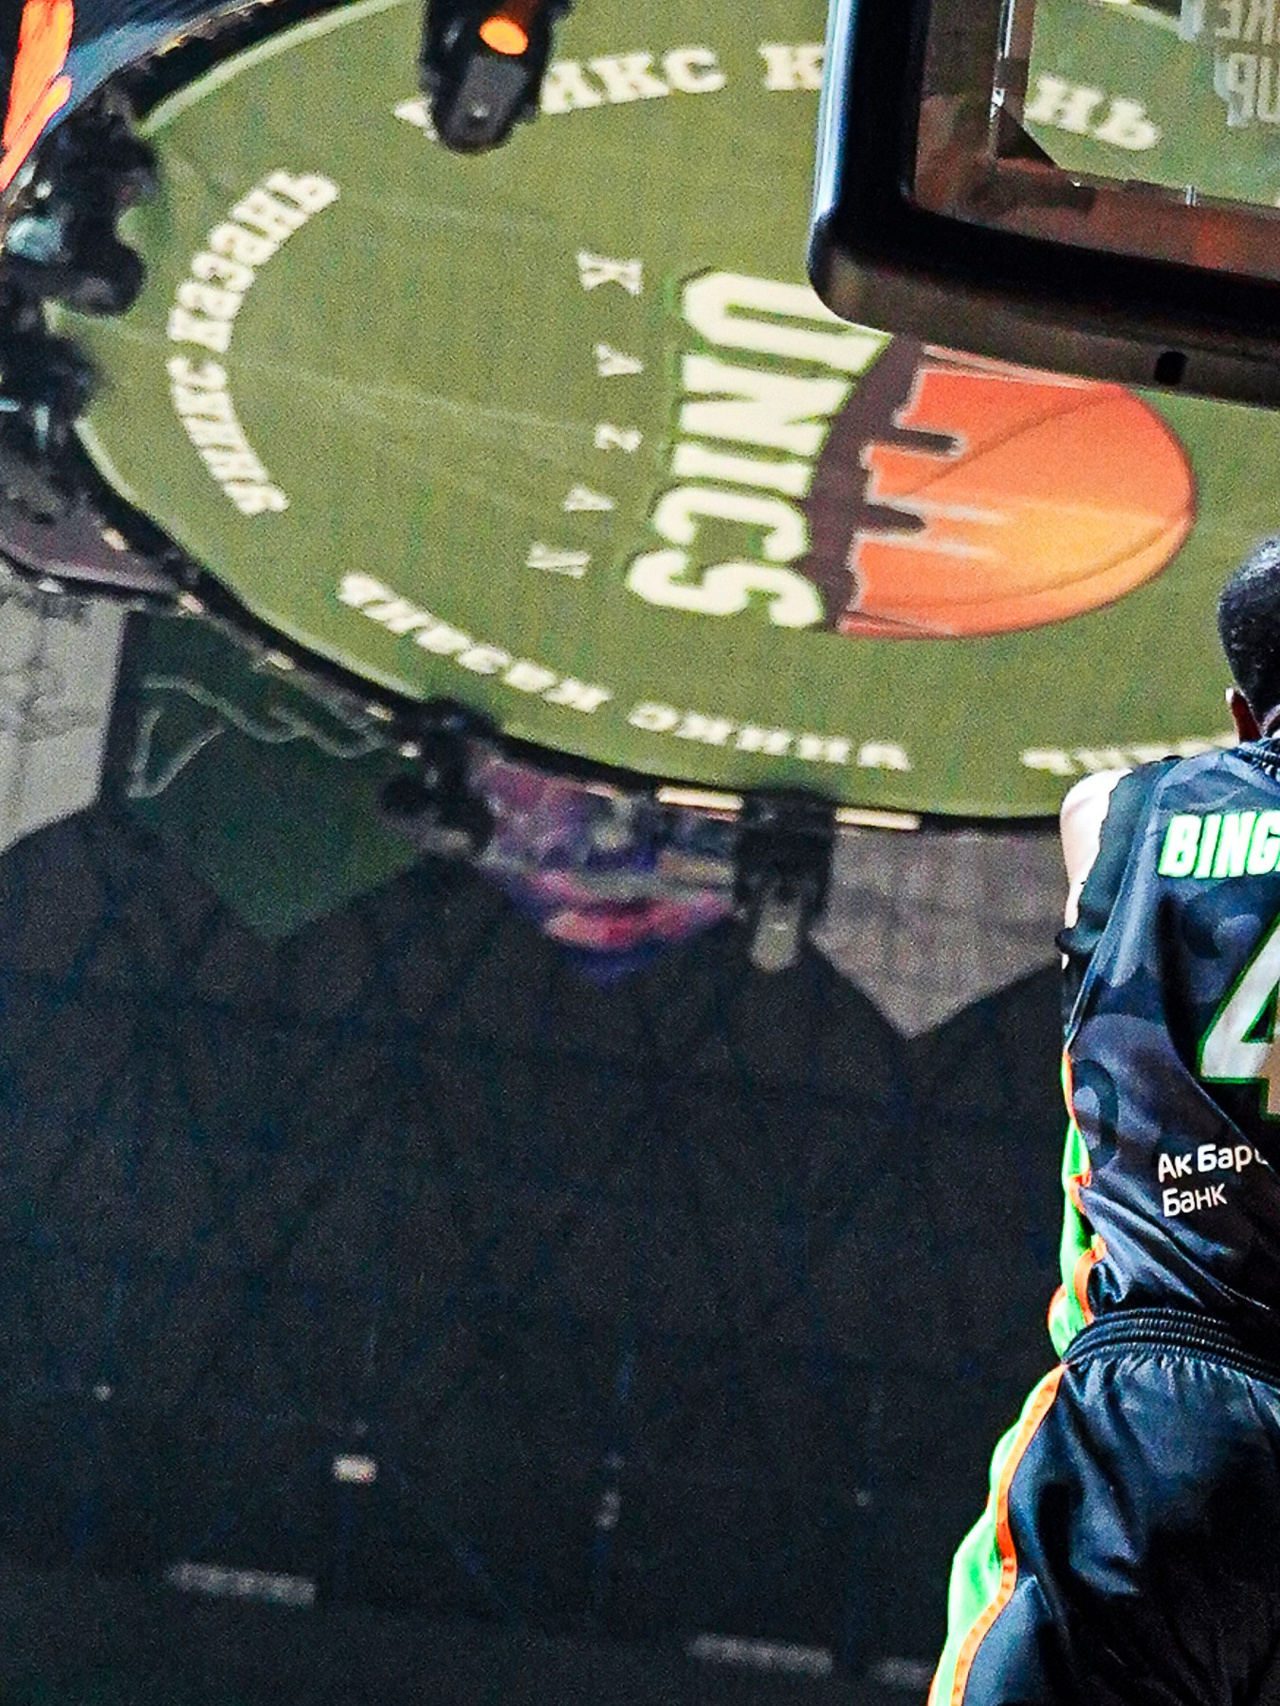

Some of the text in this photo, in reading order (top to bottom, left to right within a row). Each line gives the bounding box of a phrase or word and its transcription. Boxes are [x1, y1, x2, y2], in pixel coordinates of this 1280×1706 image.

[629, 271, 893, 629] UNICS
[1157, 1152, 1193, 1183] Ак
[1162, 1182, 1228, 1217] Банк
